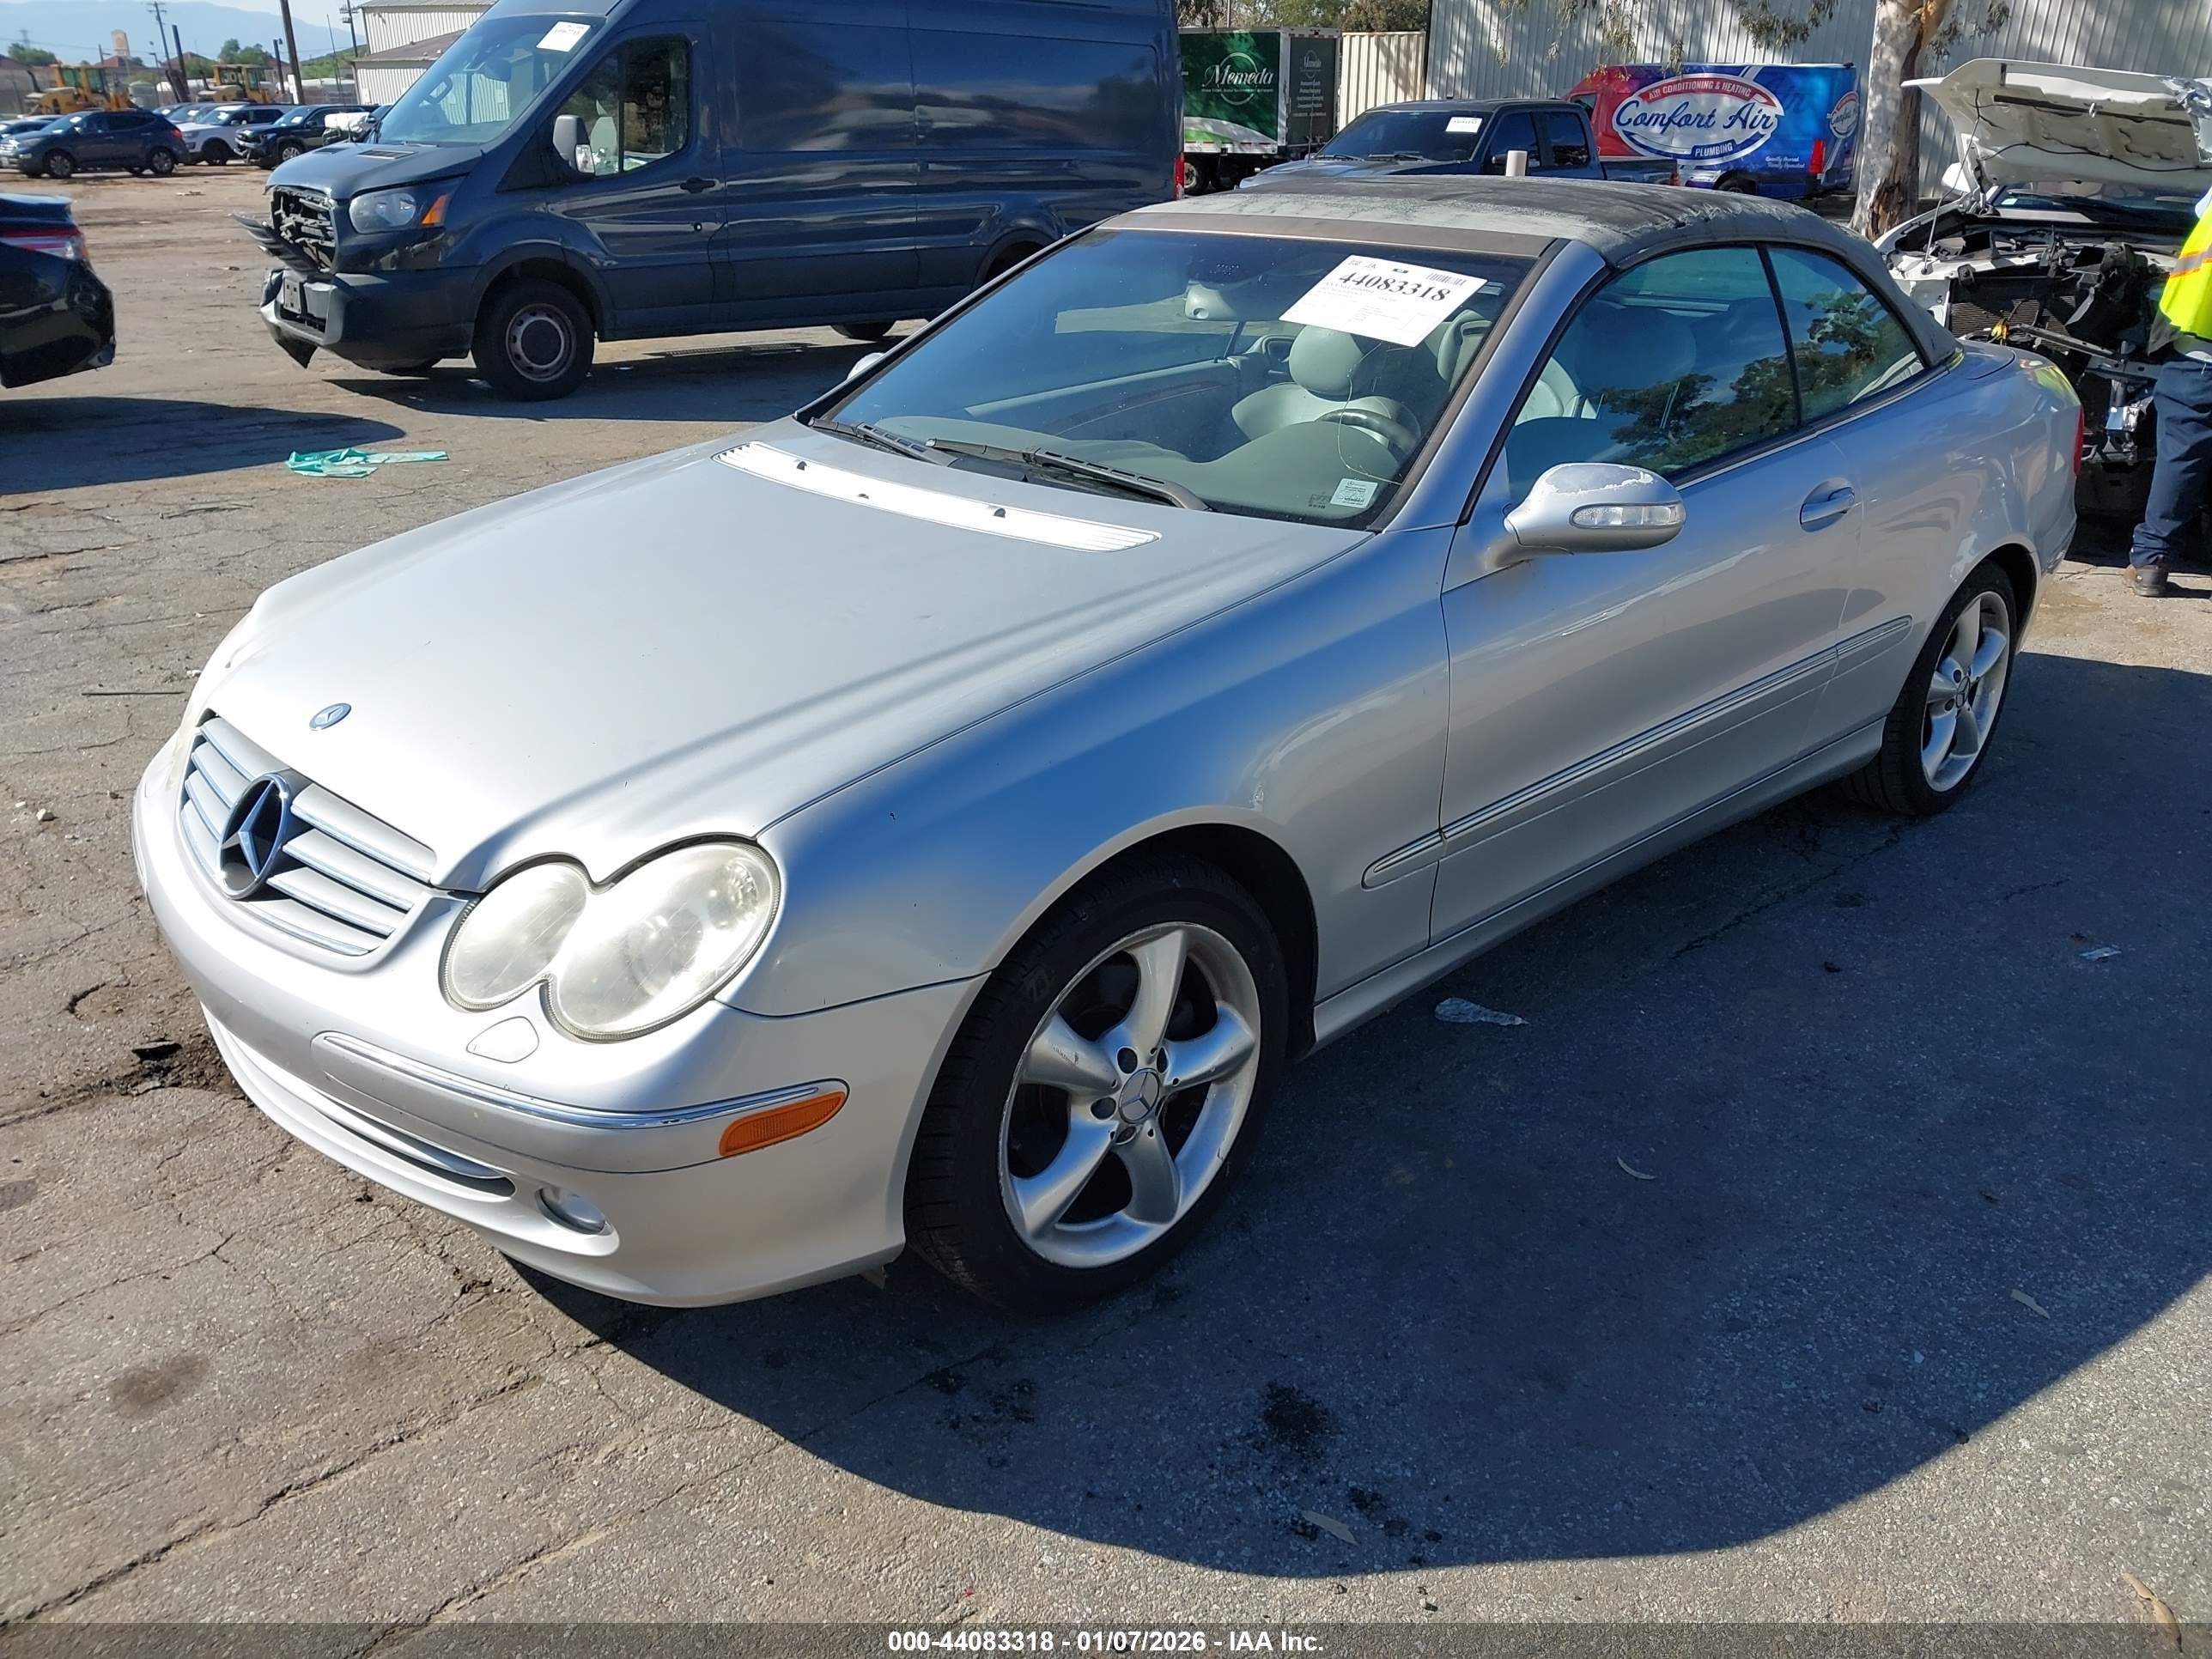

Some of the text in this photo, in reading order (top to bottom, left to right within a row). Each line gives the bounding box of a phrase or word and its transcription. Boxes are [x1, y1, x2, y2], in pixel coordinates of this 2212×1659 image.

[1202, 64, 1274, 87] Memeda
[1649, 81, 1752, 100] AIR CONDITIONING & HEATING
[1615, 100, 1774, 134] Comfort Air
[1694, 143, 1734, 157] PLUMBING
[1339, 271, 1451, 302] 44083318
